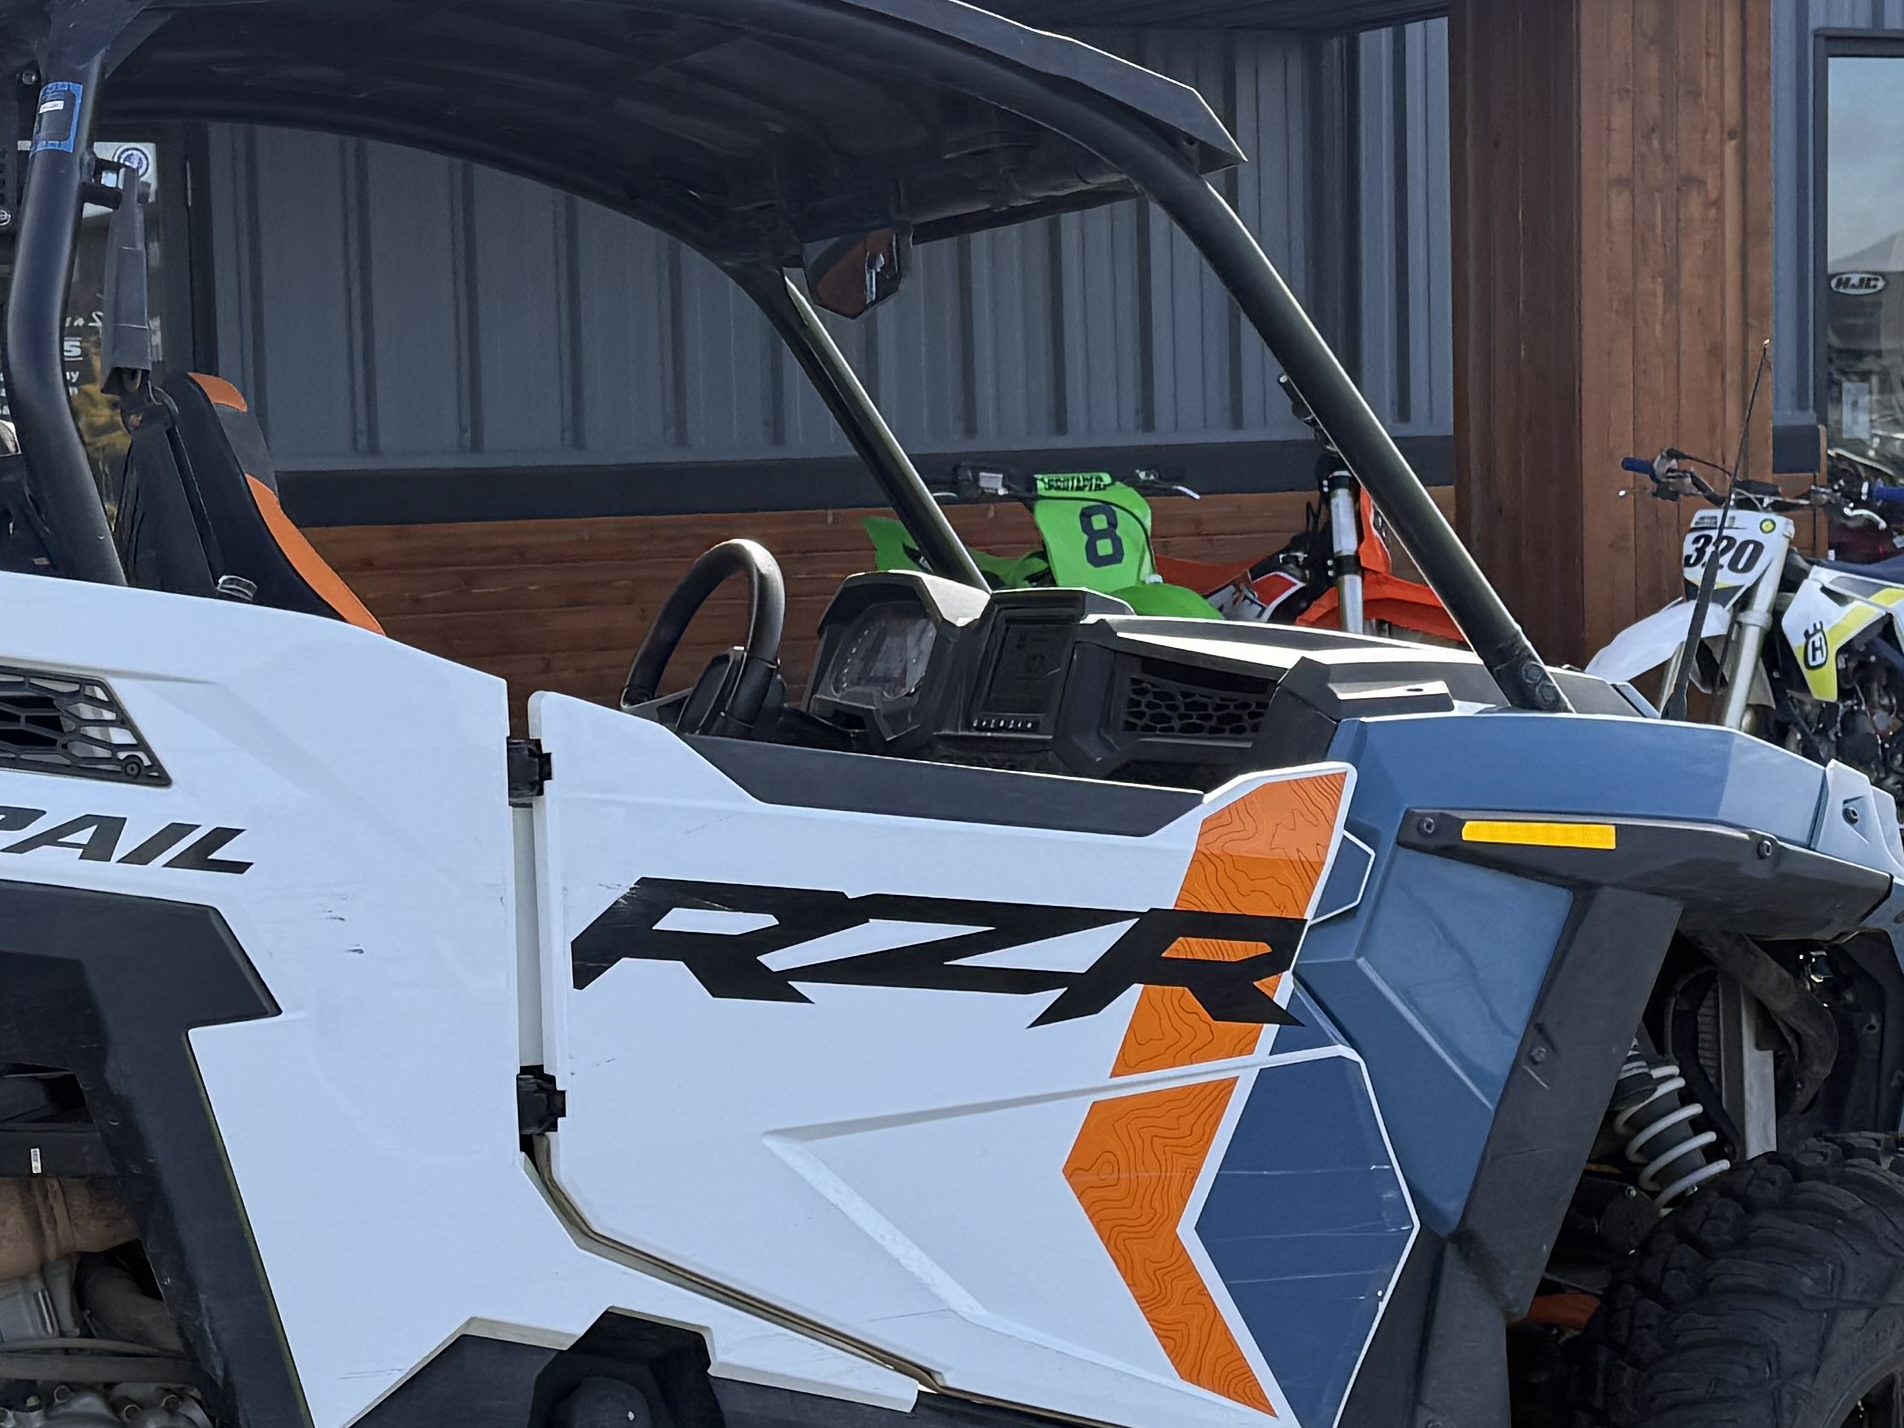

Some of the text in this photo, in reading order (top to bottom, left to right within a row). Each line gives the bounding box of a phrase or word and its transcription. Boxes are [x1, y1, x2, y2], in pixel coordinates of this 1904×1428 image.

[1835, 277, 1880, 290] HJC
[1079, 504, 1125, 568] 8
[1684, 533, 1765, 573] 320
[571, 876, 1309, 1029] RZR
